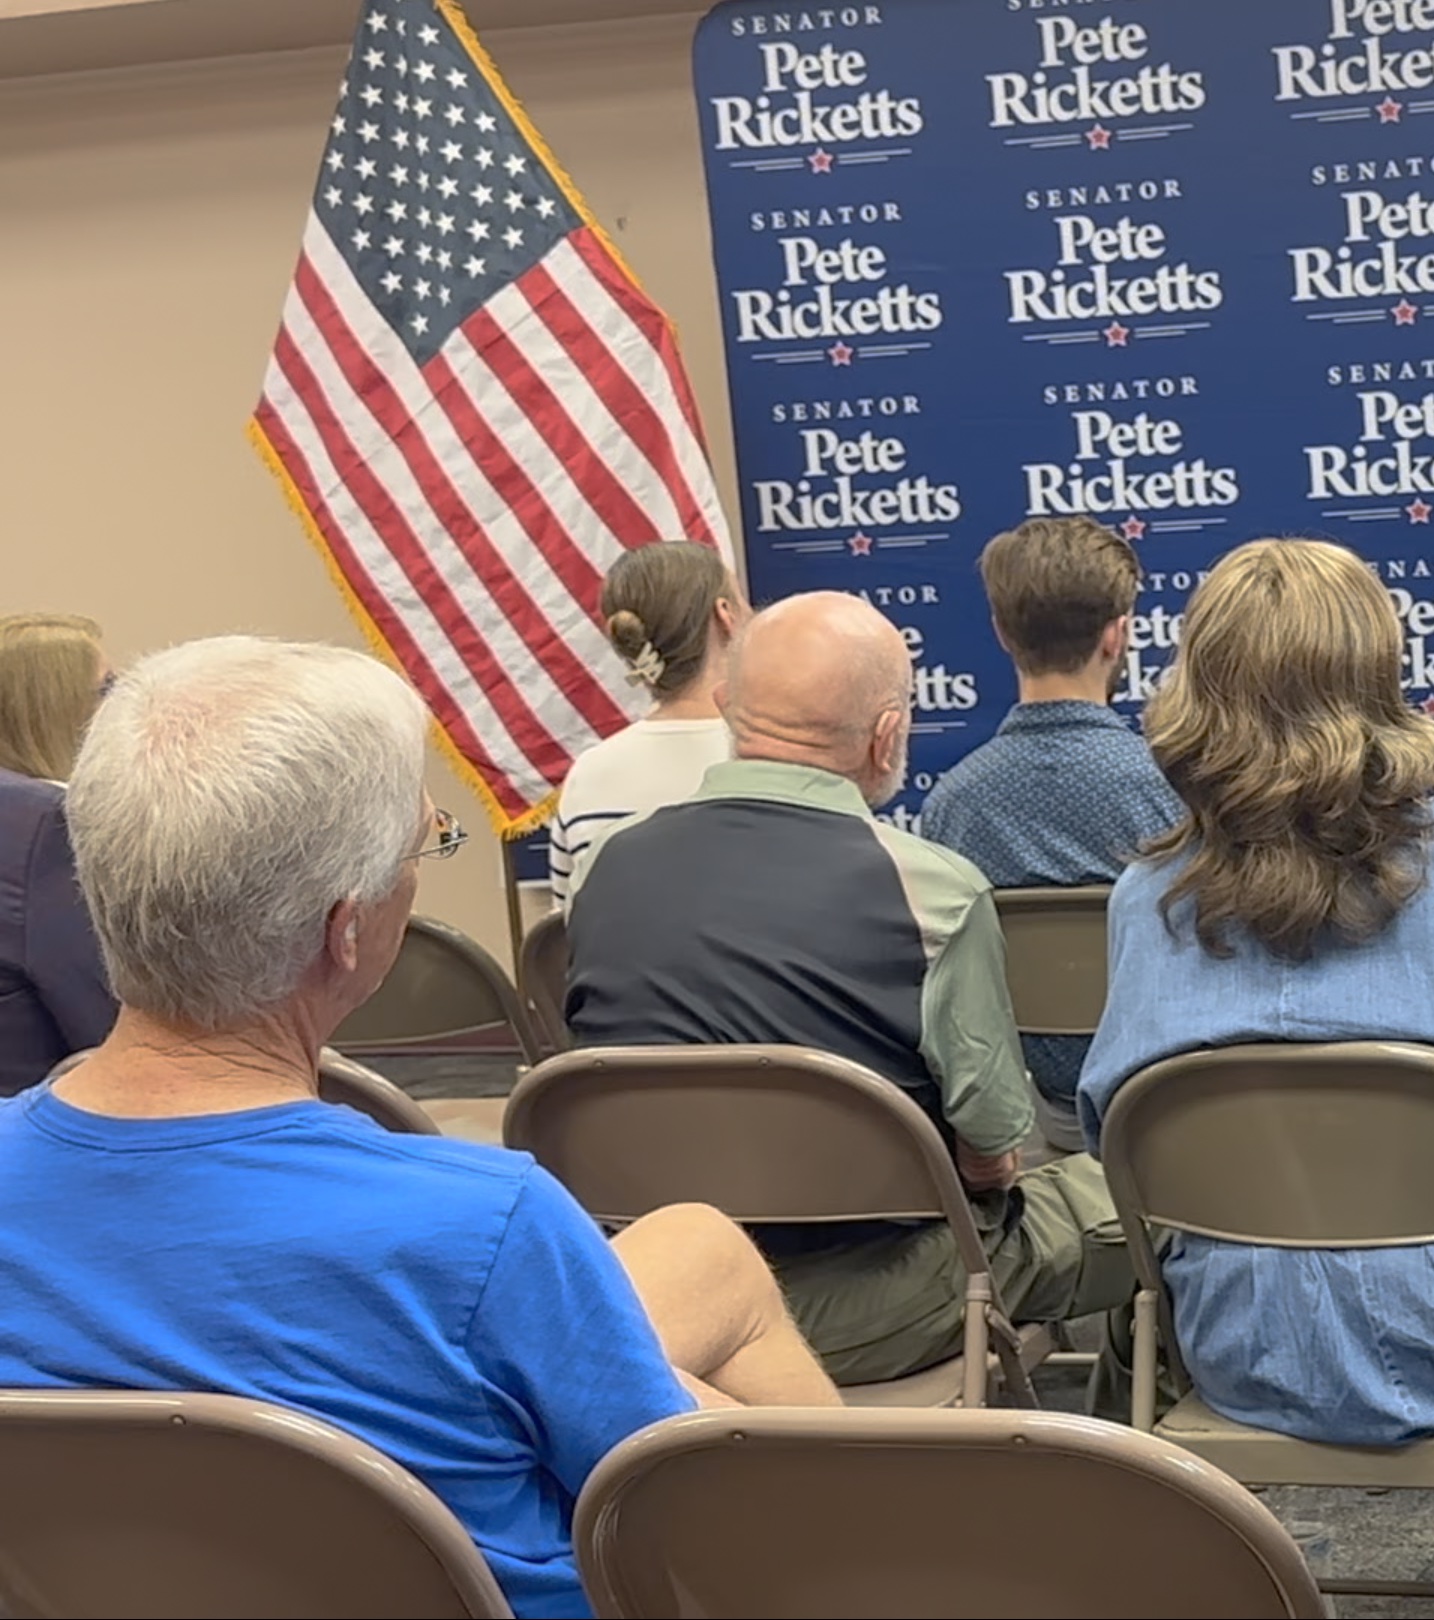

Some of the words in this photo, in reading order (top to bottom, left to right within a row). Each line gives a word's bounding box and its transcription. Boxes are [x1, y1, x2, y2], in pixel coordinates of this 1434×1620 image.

[732, 6, 882, 36] SENATOR
[1036, 16, 1147, 68] Pete
[759, 42, 867, 92] Pete
[711, 89, 923, 150] Ricketts
[985, 63, 1206, 127] Ricketts
[751, 202, 901, 231] SENATOR
[1026, 179, 1182, 209] SENATOR
[778, 237, 886, 286] Pete
[1054, 215, 1165, 266] Pete
[732, 284, 942, 342] Ricketts
[1003, 263, 1223, 323] Ricketts
[773, 395, 921, 422] SENATOR
[1044, 376, 1198, 405] SENATOR
[800, 428, 906, 477] Pete
[1071, 410, 1182, 460] Pete
[753, 475, 961, 531] Ricketts
[1022, 458, 1239, 516] Ricketts
